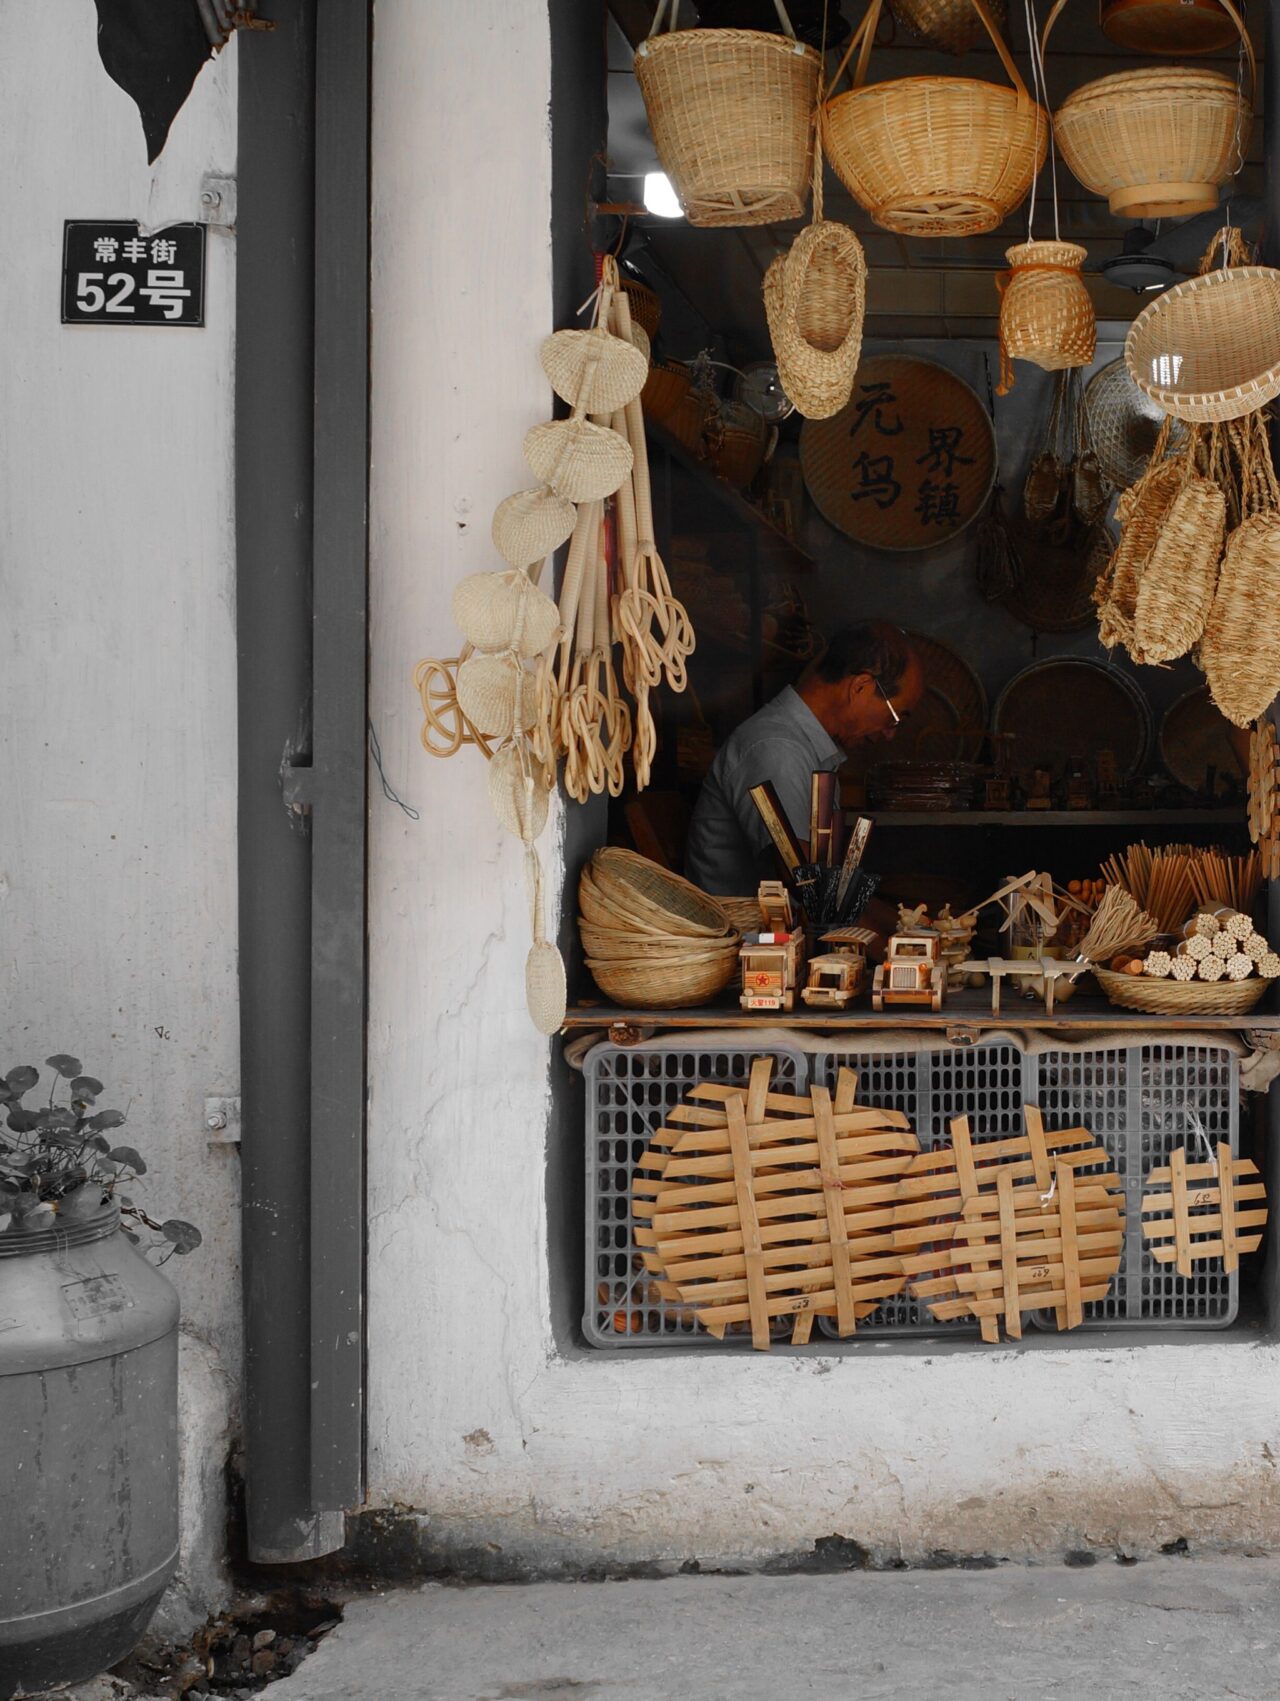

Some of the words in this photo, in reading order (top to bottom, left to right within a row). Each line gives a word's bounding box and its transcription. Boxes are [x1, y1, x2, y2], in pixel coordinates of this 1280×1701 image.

[93, 237, 178, 265] 常丰街
[76, 269, 192, 319] 52号
